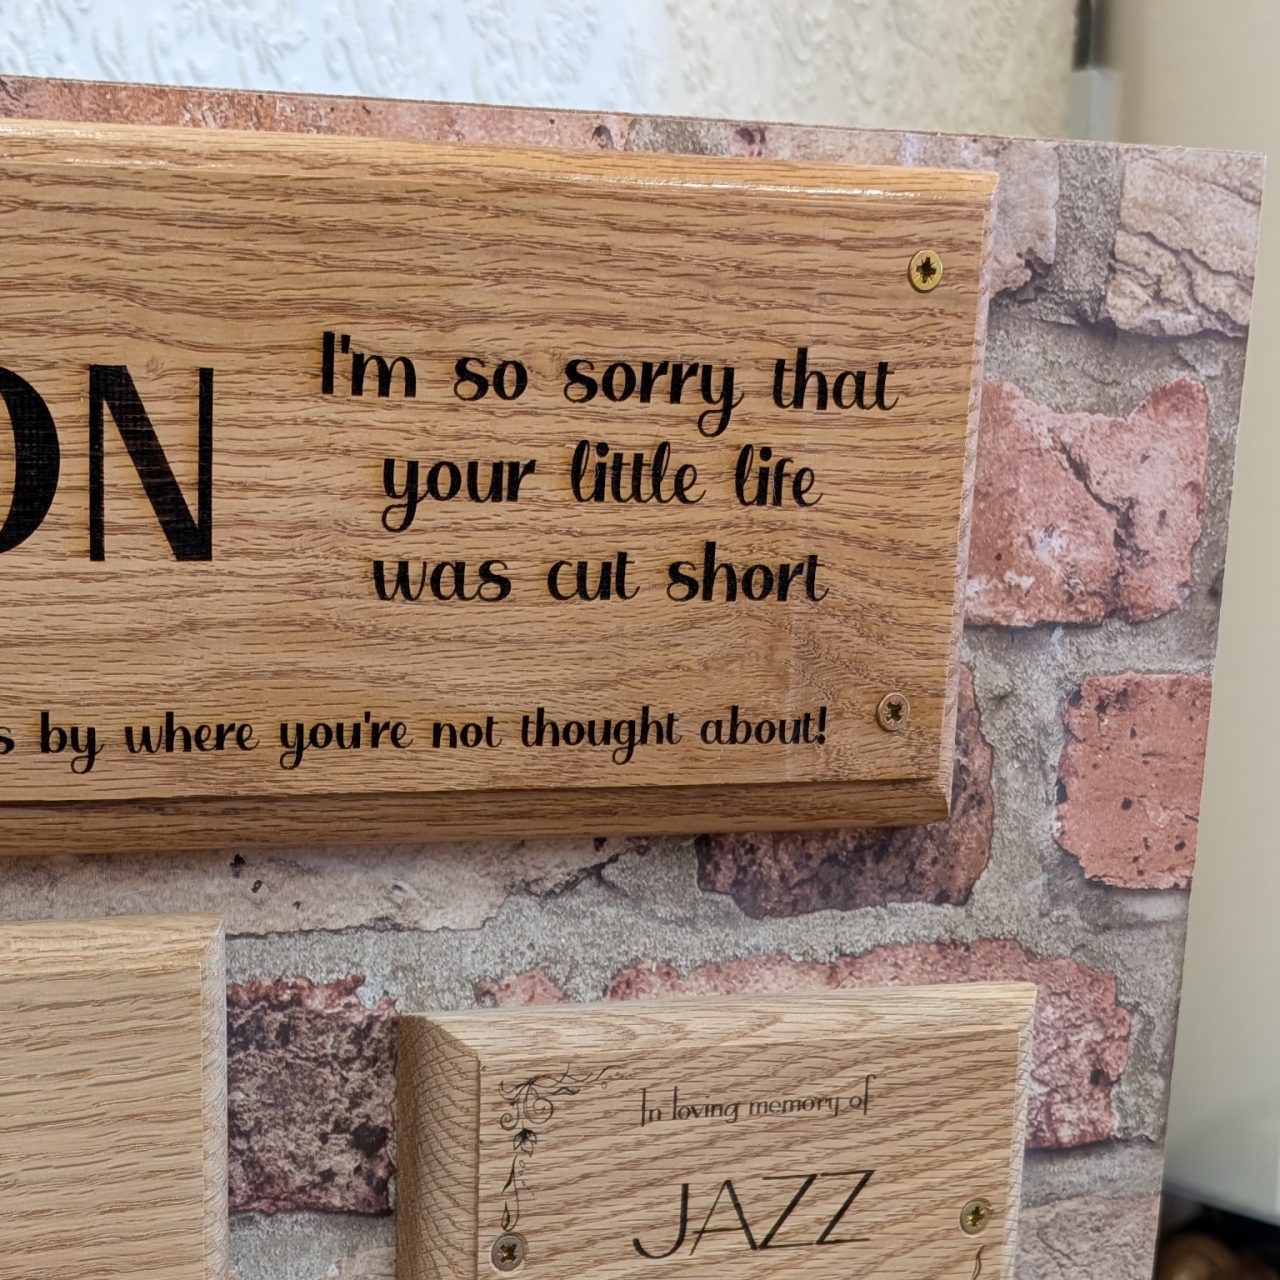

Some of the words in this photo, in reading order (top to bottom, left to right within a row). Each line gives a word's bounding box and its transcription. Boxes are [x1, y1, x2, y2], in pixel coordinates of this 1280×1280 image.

[320, 332, 416, 398] I'm
[453, 355, 528, 401] so
[564, 356, 744, 437] sorry
[771, 347, 899, 411] that
[381, 457, 536, 532] your
[570, 439, 706, 503] little
[734, 444, 822, 507] life
[373, 558, 512, 602] was
[547, 551, 639, 601] cut
[667, 541, 828, 602] short
[41, 712, 104, 774] by
[123, 710, 260, 754] where
[279, 711, 412, 769] you're
[432, 711, 502, 749] not
[521, 705, 683, 764] thought
[699, 706, 828, 746] about!
[641, 1088, 662, 1127] In
[673, 1085, 741, 1123] loving
[748, 1092, 840, 1117] memory
[849, 1074, 876, 1116] of
[632, 1169, 876, 1259] JAZZ
